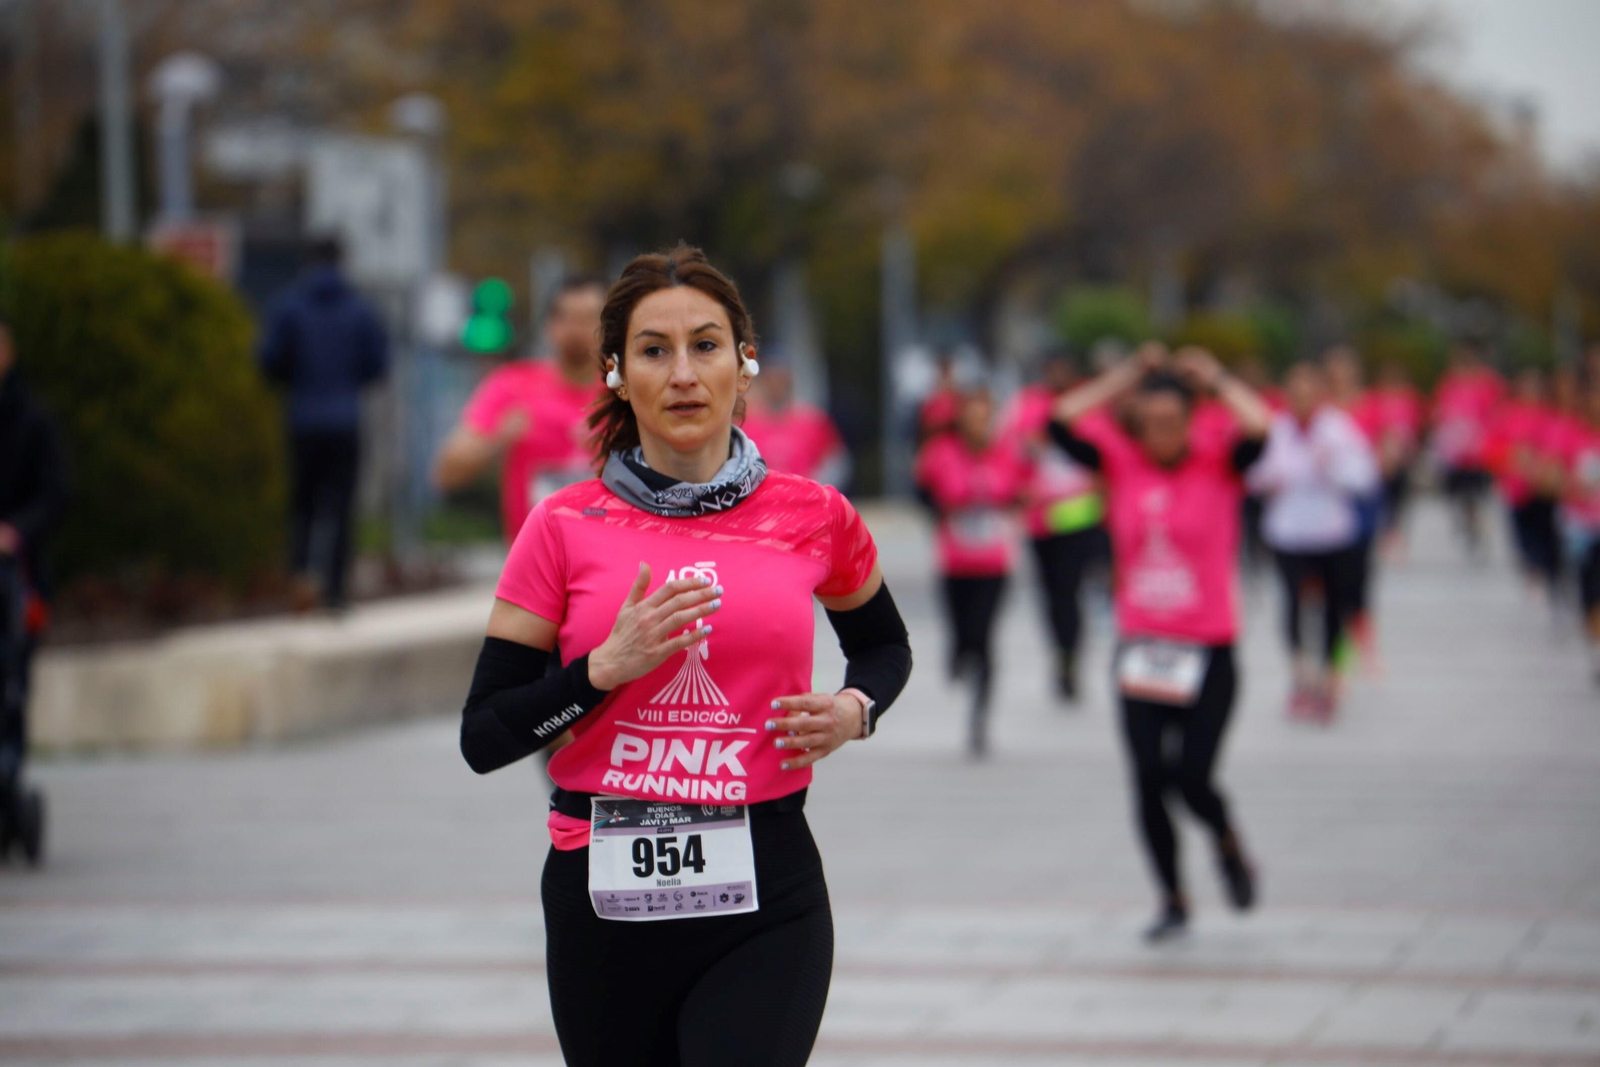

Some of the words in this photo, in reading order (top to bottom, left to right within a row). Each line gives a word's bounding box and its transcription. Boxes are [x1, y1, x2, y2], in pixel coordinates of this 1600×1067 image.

[532, 702, 584, 738] KIPRUN
[637, 708, 662, 722] VIII
[668, 709, 741, 725] EDICIÓN
[610, 732, 750, 776] PINK
[602, 768, 747, 800] RUNNING
[647, 805, 682, 813] BUENOS
[670, 816, 691, 824] MAR
[632, 834, 706, 878] 954
[656, 878, 682, 887] Noelia
